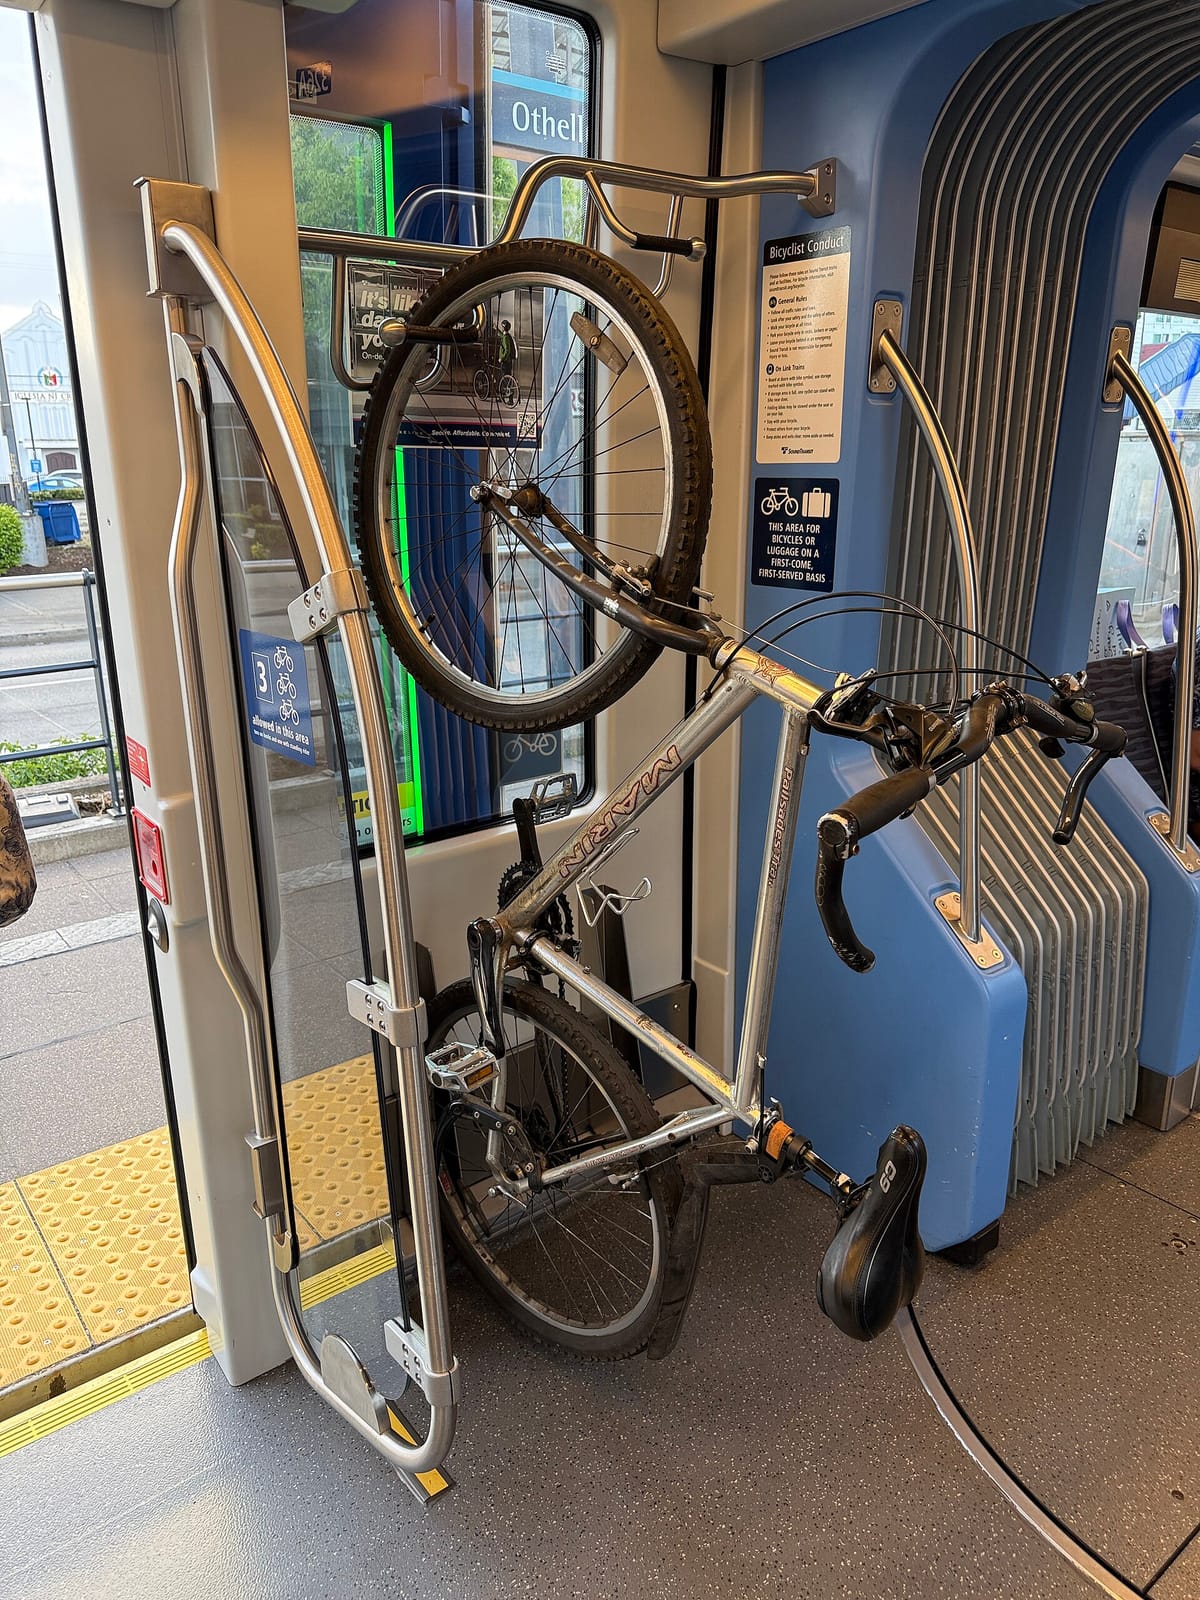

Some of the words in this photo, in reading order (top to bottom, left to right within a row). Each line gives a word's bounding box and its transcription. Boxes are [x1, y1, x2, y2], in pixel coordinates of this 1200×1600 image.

[769, 243, 804, 260] Bicyclist
[807, 236, 844, 253] Conduct
[360, 290, 388, 309] It's
[769, 522, 783, 532] THIS
[785, 523, 804, 533] AREA
[806, 524, 820, 534] FOR
[771, 534, 803, 545] BICYCLES
[805, 536, 815, 546] OR
[767, 546, 799, 557] LUGGAGE
[801, 548, 812, 558] ON
[813, 549, 820, 559] A
[771, 558, 814, 571] FIRST-COME,
[758, 569, 804, 581] FIRST-SERVED
[805, 572, 826, 583] BASIS
[256, 660, 268, 693] 3
[252, 715, 275, 732] allowed
[275, 722, 282, 735] in
[282, 725, 295, 740] this
[295, 732, 310, 745] area
[558, 744, 682, 878] MARIN
